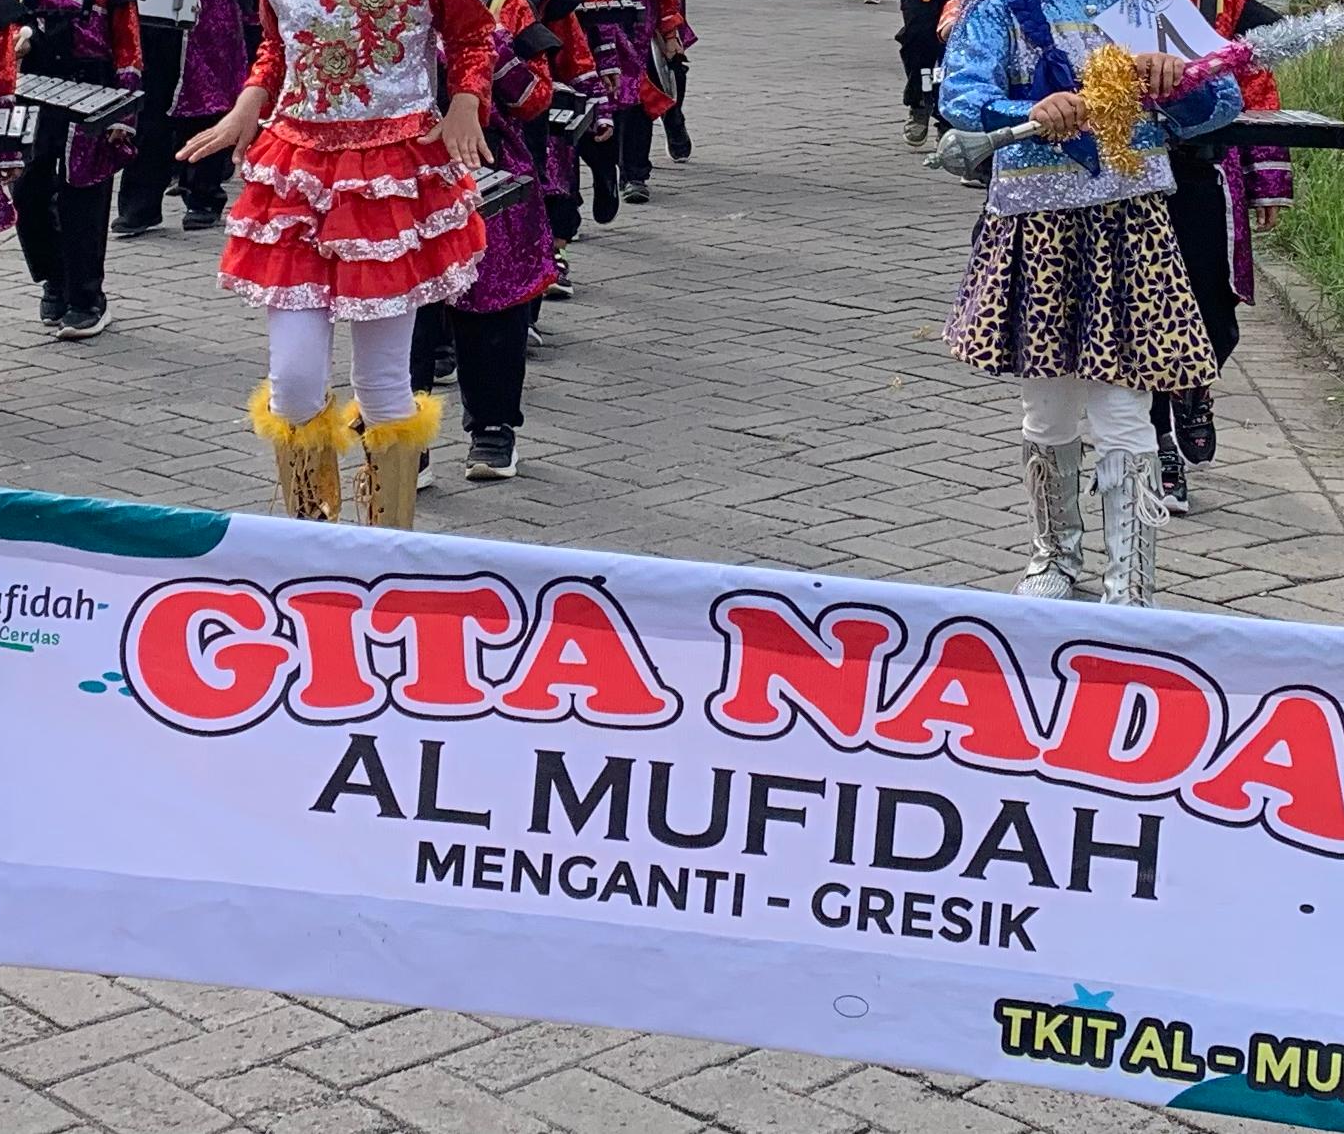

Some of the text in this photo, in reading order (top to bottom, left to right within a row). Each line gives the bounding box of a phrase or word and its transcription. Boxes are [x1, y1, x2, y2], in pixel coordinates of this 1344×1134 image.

[122, 574, 681, 735] GITA
[308, 732, 1164, 901] AL MUFIDAH
[414, 840, 747, 918] MENGANTI
[810, 881, 1040, 953] GRESIK
[1000, 1003, 1120, 1061] TKIT
[1126, 1022, 1200, 1076] AL
